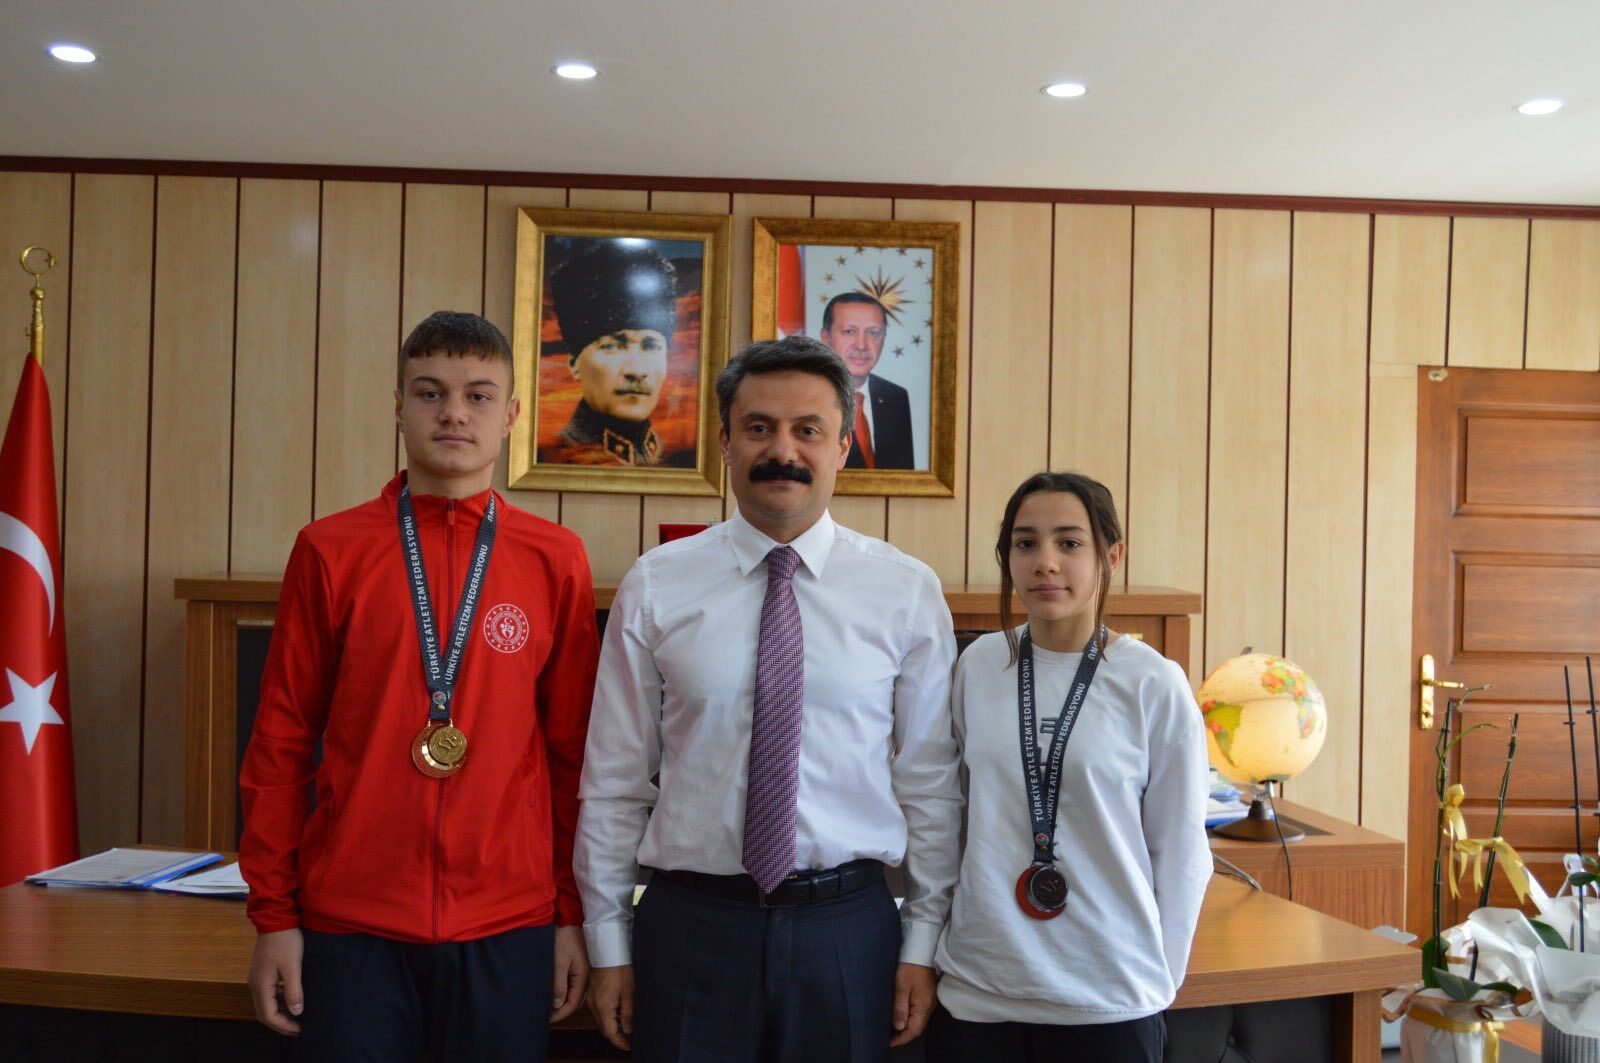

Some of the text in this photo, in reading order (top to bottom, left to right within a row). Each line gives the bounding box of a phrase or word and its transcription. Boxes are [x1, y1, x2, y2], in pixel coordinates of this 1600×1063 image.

[403, 516, 424, 586] FEDERASYONU
[416, 586, 434, 635] ATLETİZM
[454, 606, 473, 647] ATLETİZM
[467, 544, 489, 605] FEDERASYONU
[426, 636, 441, 681] TÜRKİYE
[1022, 659, 1044, 822] TÜRKİYE ATLETİZM FEDERASYONU
[1049, 743, 1063, 786] ATLETİZM
[1059, 683, 1086, 743] FEDERASYONU
